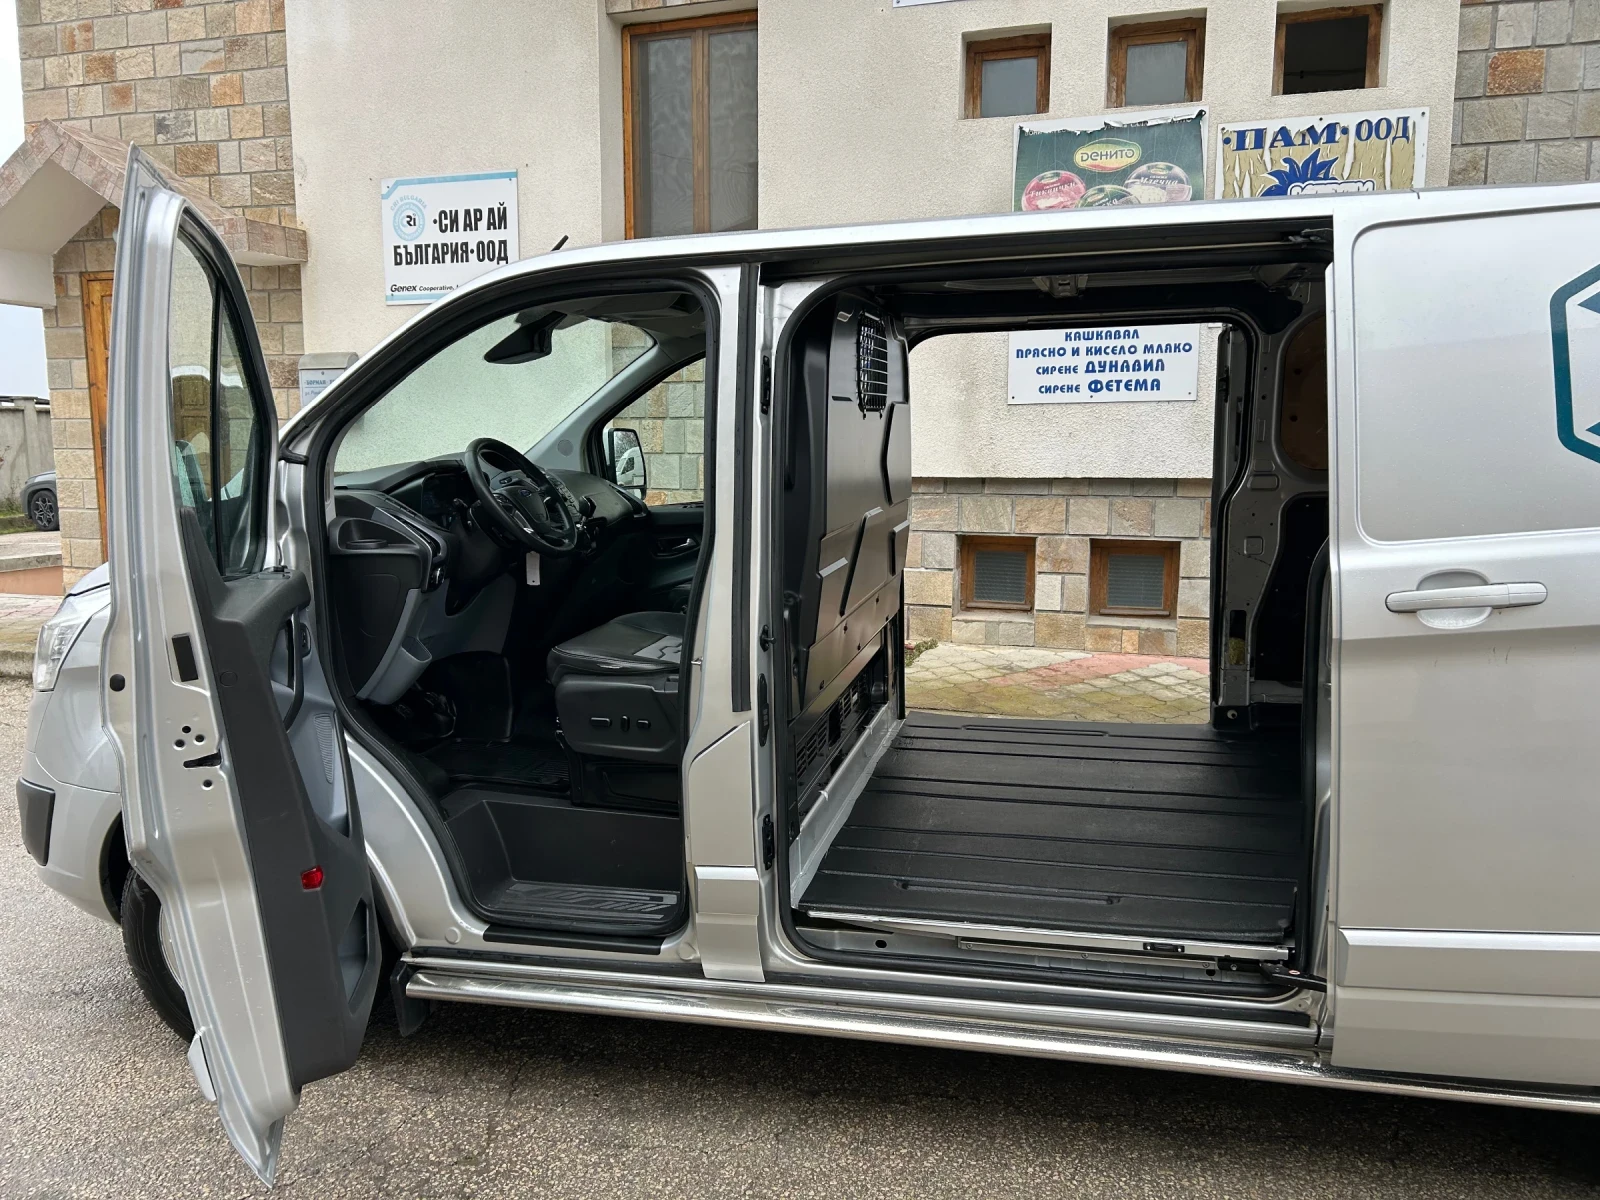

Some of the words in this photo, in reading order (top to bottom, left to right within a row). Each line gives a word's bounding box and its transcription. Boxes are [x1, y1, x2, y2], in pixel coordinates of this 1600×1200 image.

[1232, 122, 1341, 152] ПАМ
[1355, 116, 1410, 145] ООД
[463, 208, 483, 232] АР
[486, 201, 508, 231] АЙ
[390, 284, 418, 293] Genex
[1064, 328, 1140, 342] КАШКАВАЛ
[1015, 346, 1067, 359] ПРЯСНО
[1071, 346, 1080, 357] И
[1085, 344, 1138, 356] КИСЕЛО
[1142, 342, 1193, 355] МЛЯКО
[1087, 378, 1161, 394] ФЕТЕМА
